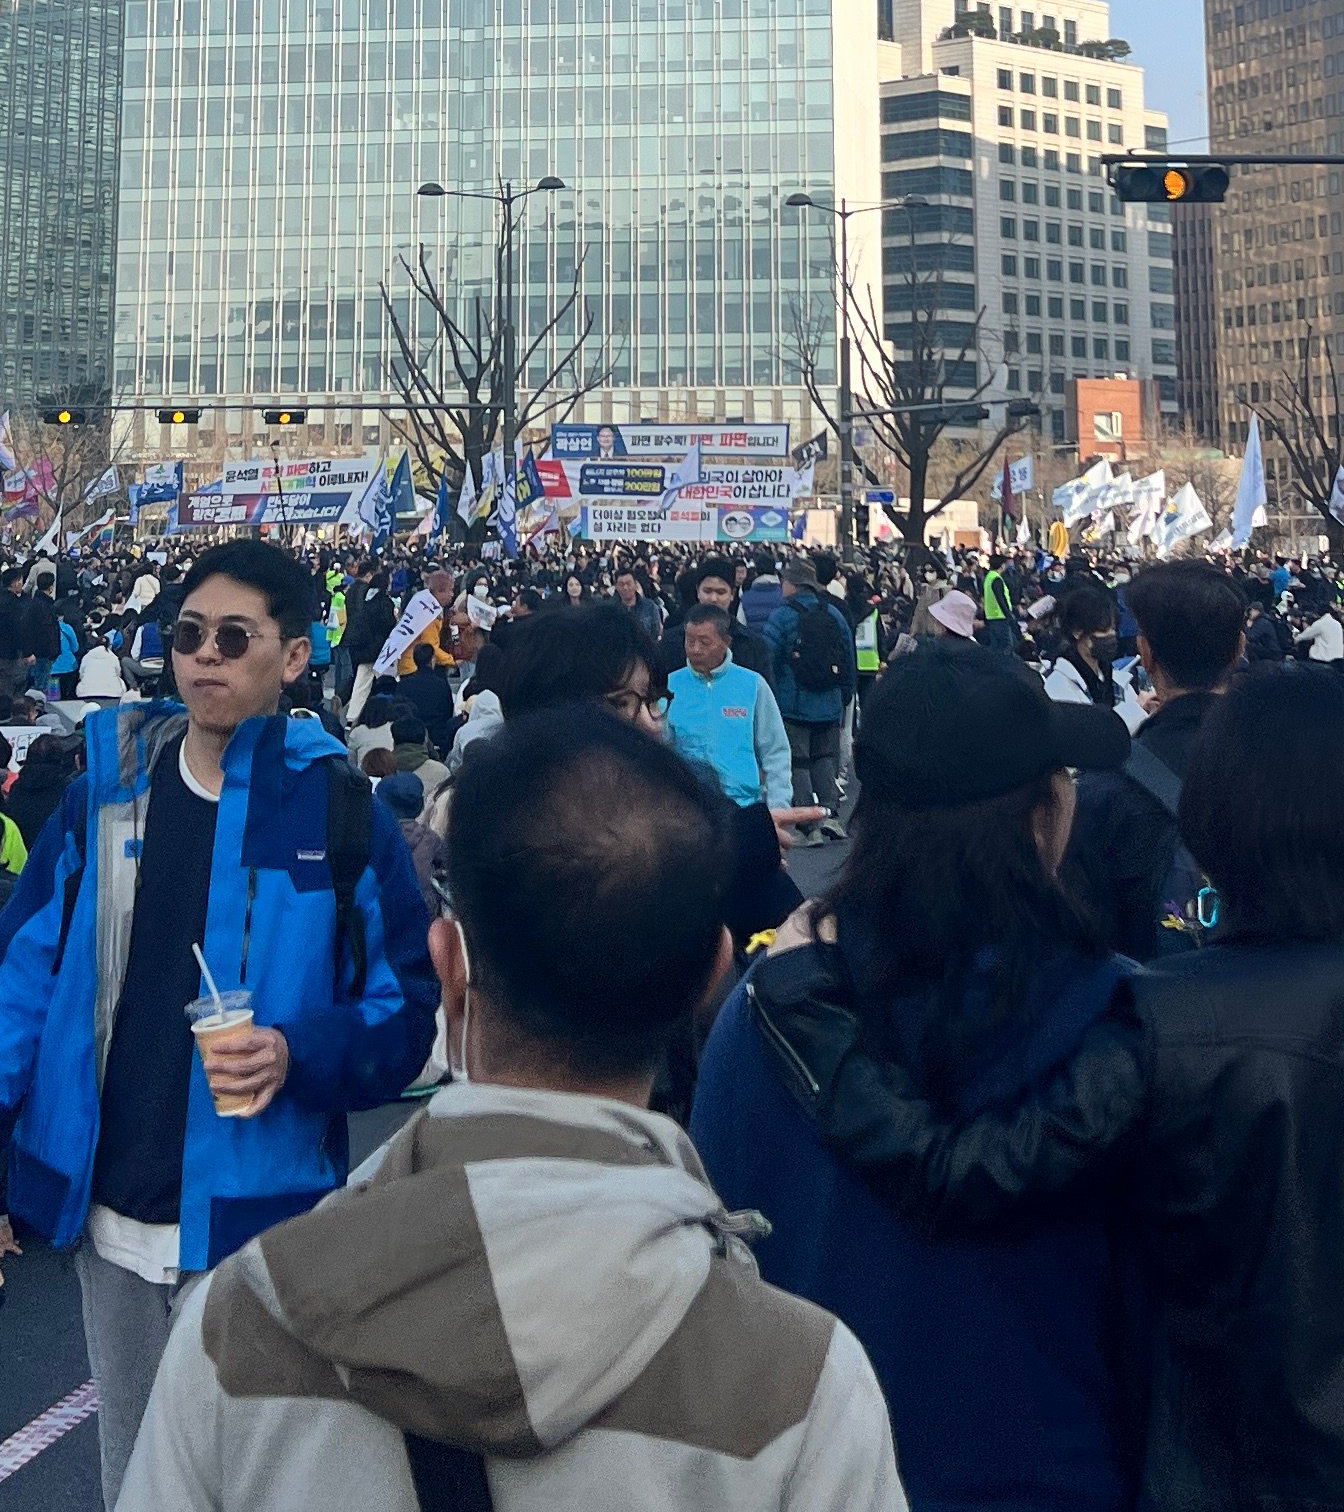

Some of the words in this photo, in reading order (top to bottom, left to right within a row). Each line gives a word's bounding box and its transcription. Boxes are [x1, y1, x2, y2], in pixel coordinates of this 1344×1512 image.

[225, 468, 259, 483] 윤석열
[286, 460, 332, 476] 파면하고
[742, 469, 783, 483] 살아야
[748, 484, 791, 499] 삽니다
[592, 509, 624, 521] 더이상
[606, 522, 637, 533] 자리는
[640, 522, 661, 534] 없다
